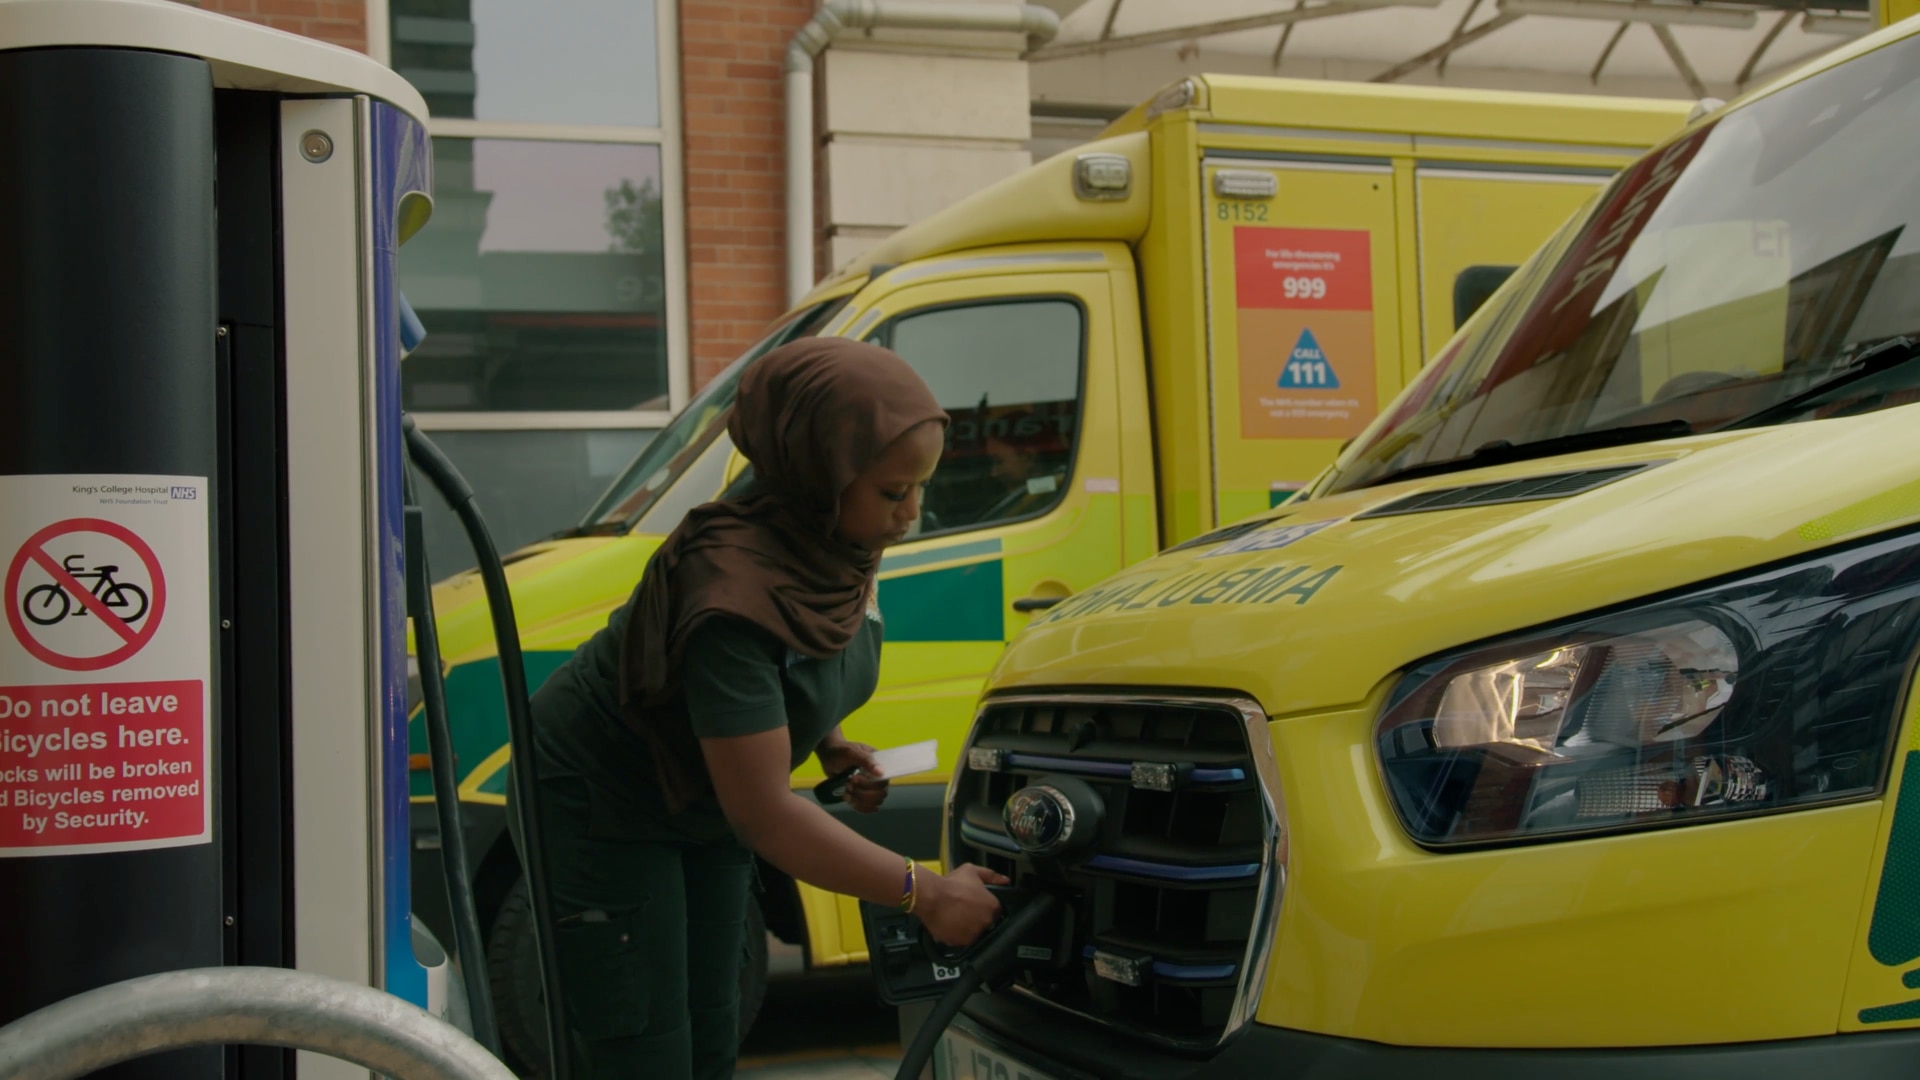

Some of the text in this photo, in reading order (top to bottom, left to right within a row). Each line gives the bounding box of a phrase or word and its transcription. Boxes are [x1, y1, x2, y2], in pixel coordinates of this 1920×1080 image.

[1217, 202, 1269, 222] 8152
[1283, 276, 1326, 298] 999
[1293, 348, 1322, 360] CALL
[1288, 361, 1327, 385] 111
[72, 485, 195, 499] King's College Hospital NHS
[0, 692, 178, 718] Do not leave
[0, 725, 189, 758] icycles here.
[45, 764, 81, 781] will
[89, 763, 115, 780] be
[122, 760, 192, 778] broken
[14, 787, 105, 810] Bicycles
[112, 780, 199, 802] removed
[23, 809, 149, 834] by Security.
